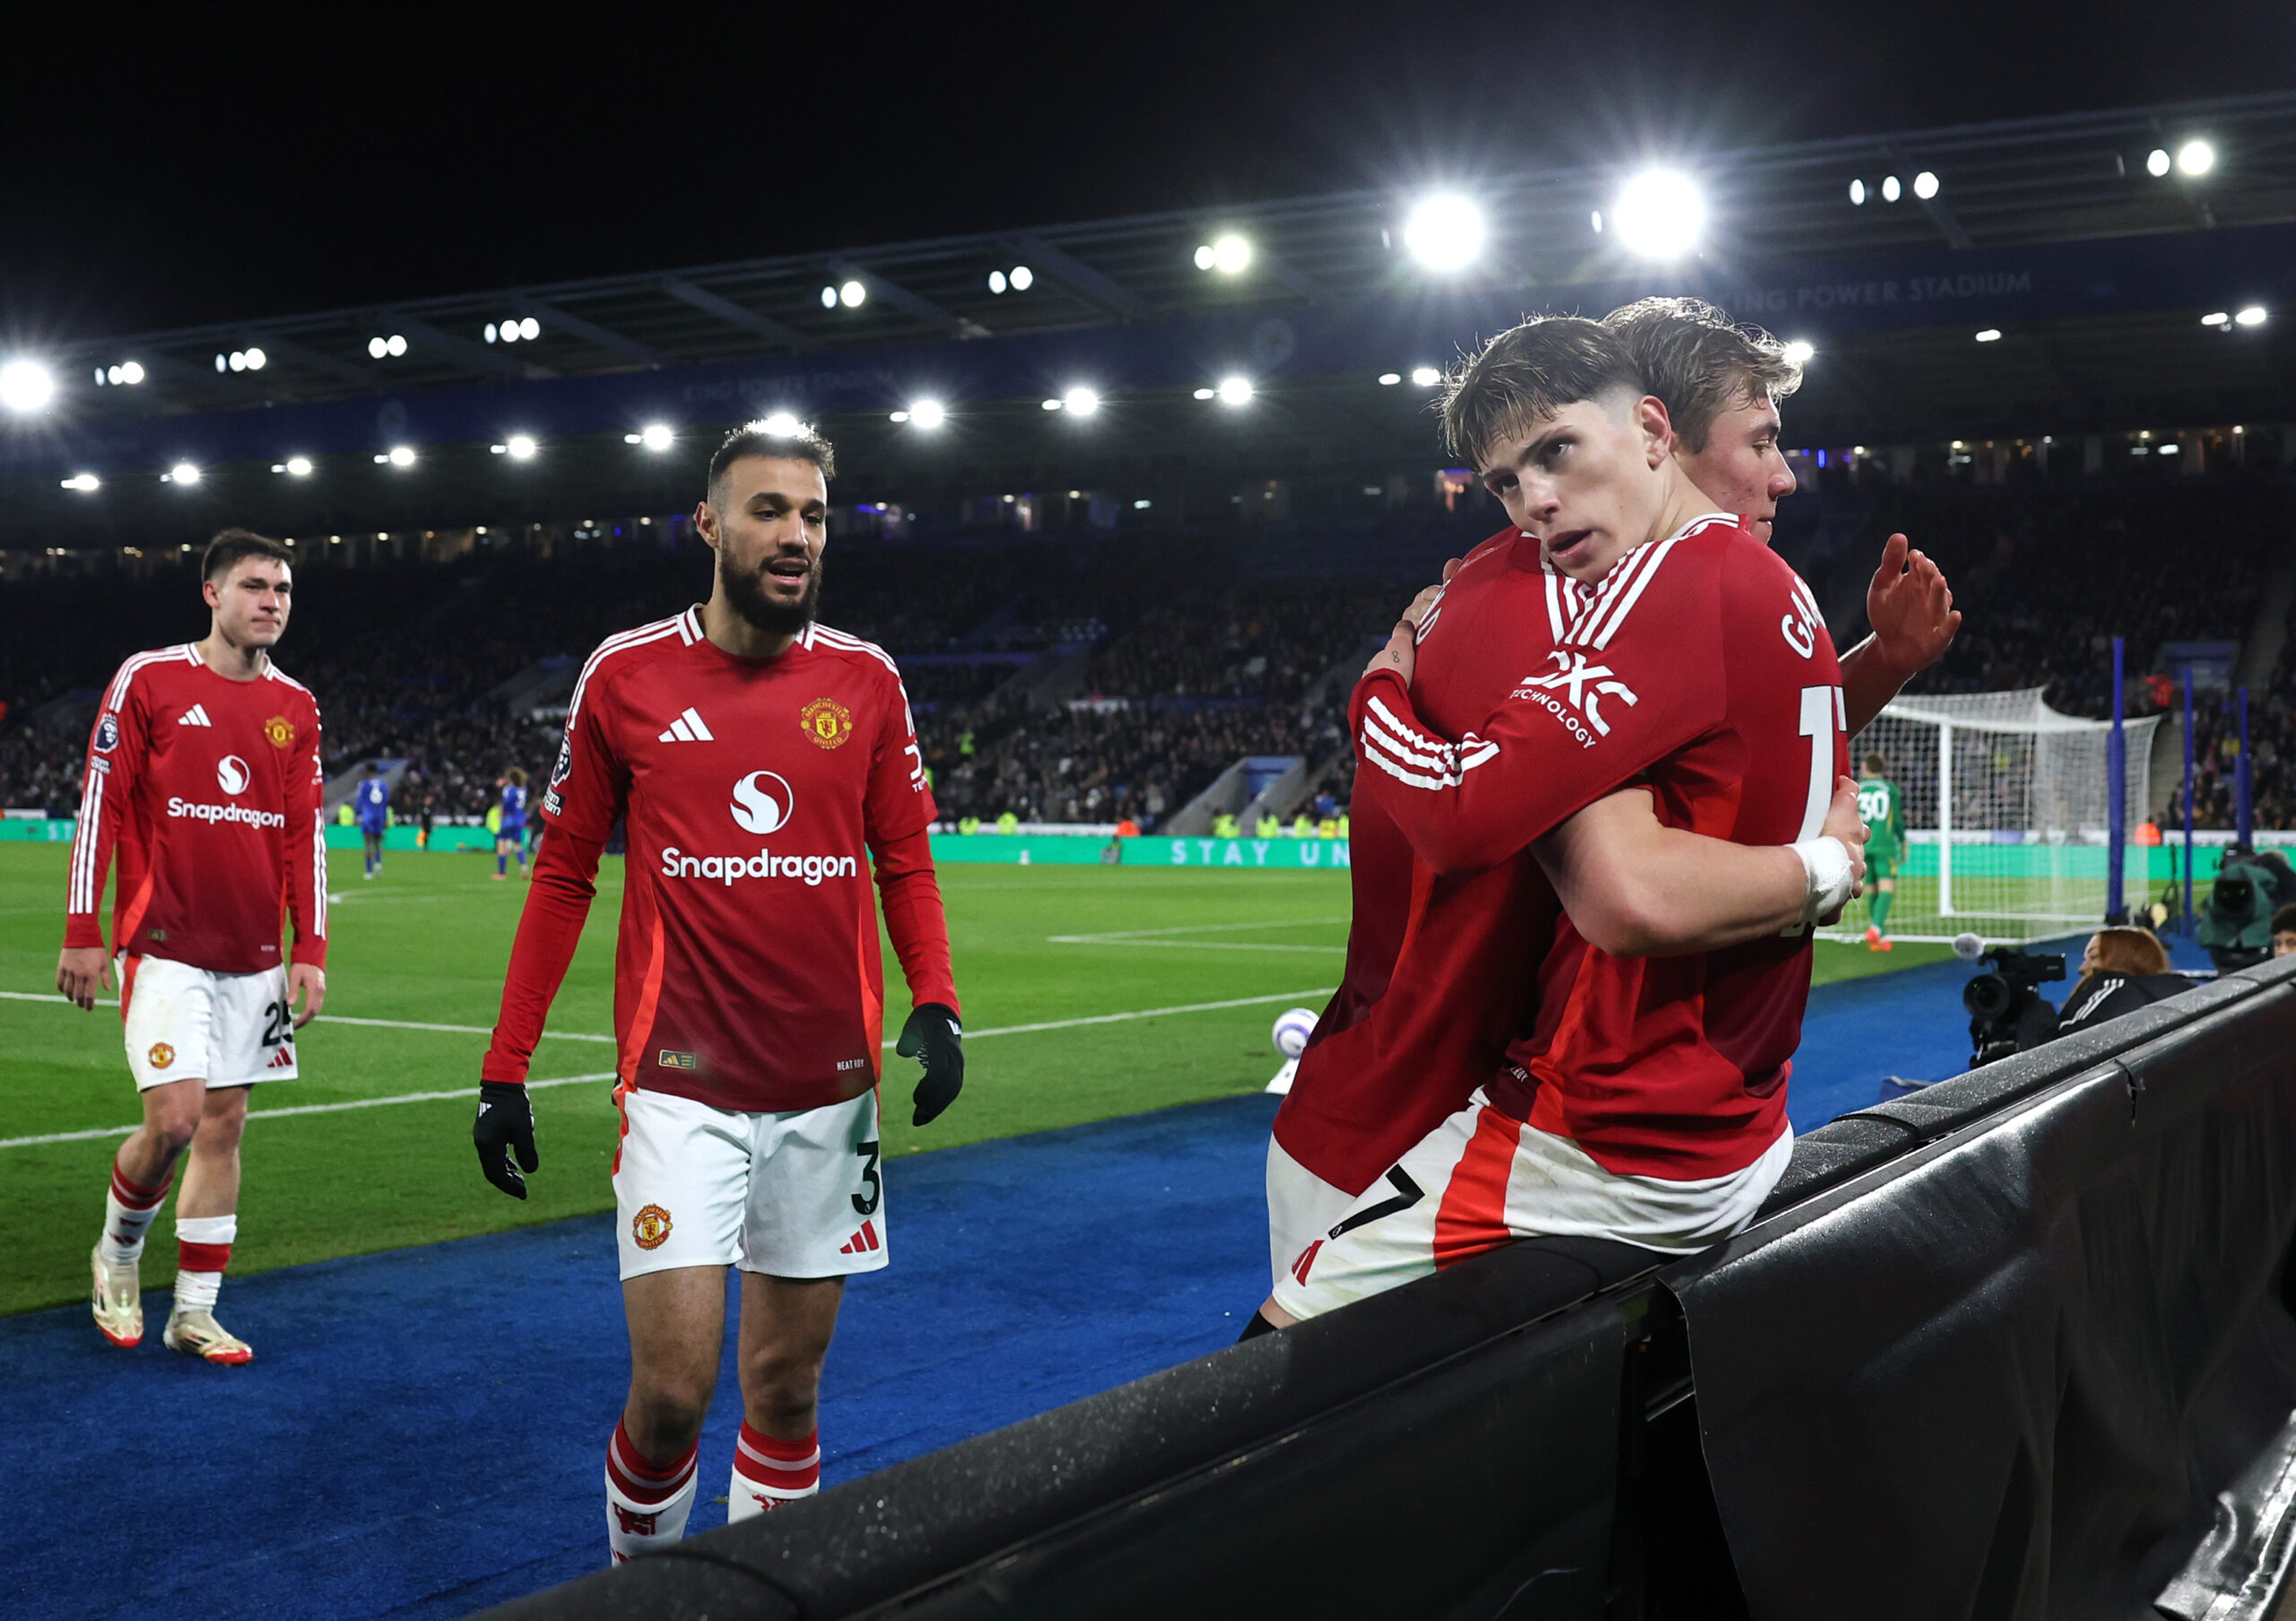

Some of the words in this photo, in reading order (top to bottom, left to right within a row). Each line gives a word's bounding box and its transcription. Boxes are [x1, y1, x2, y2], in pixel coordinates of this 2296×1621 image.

[1797, 281, 1899, 309] POWER
[1909, 273, 2032, 301] STADIUM
[804, 702, 847, 718] MANCHESTER
[1520, 650, 1639, 737] DXC
[1509, 688, 1596, 749] TECHNOLOGY
[813, 736, 843, 746] UNITED
[167, 797, 285, 830] Snapdragon
[1857, 789, 1891, 823] 30
[662, 847, 857, 886] Snapdragon
[1171, 840, 1270, 866] STAY
[851, 1140, 880, 1216] 3
[1327, 1163, 1426, 1241] 7
